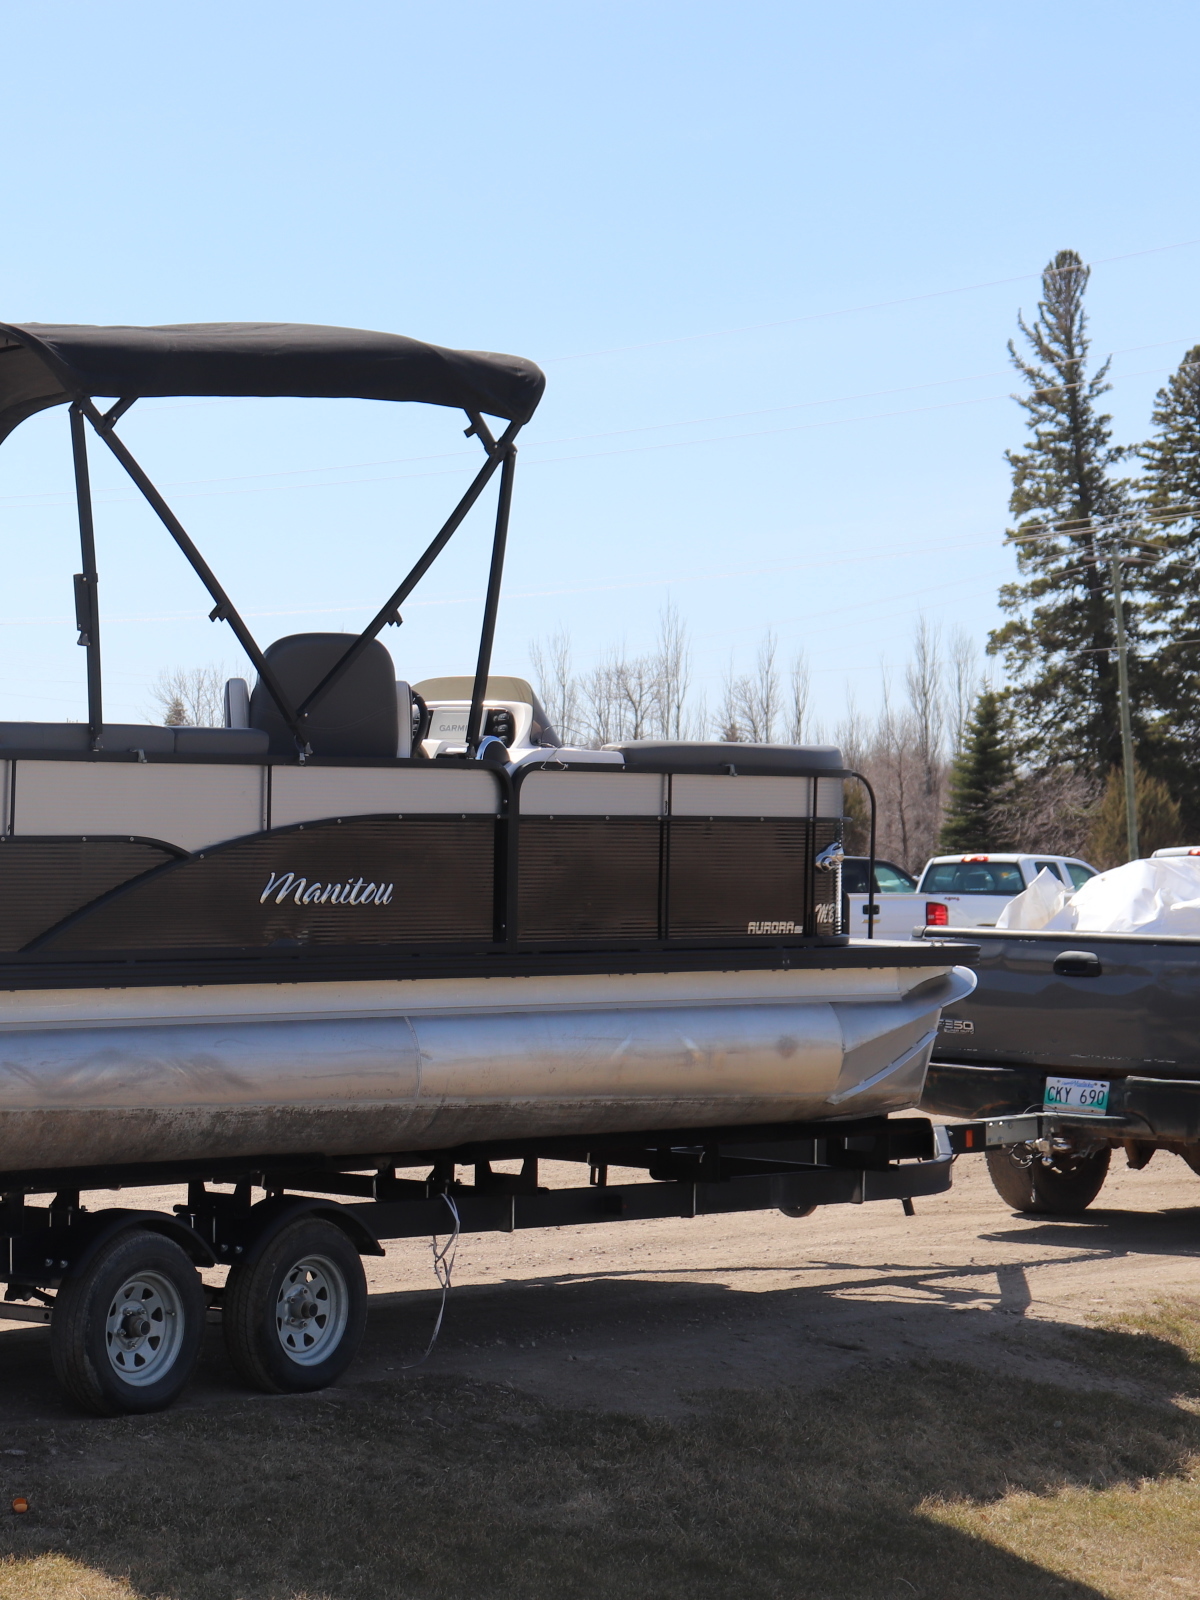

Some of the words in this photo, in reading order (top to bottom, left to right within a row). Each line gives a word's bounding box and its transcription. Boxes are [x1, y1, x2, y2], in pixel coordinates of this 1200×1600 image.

[259, 871, 394, 906] Manitou
[747, 921, 795, 935] AURORA
[1047, 1085, 1072, 1103] CKY
[1079, 1089, 1105, 1106] 690
